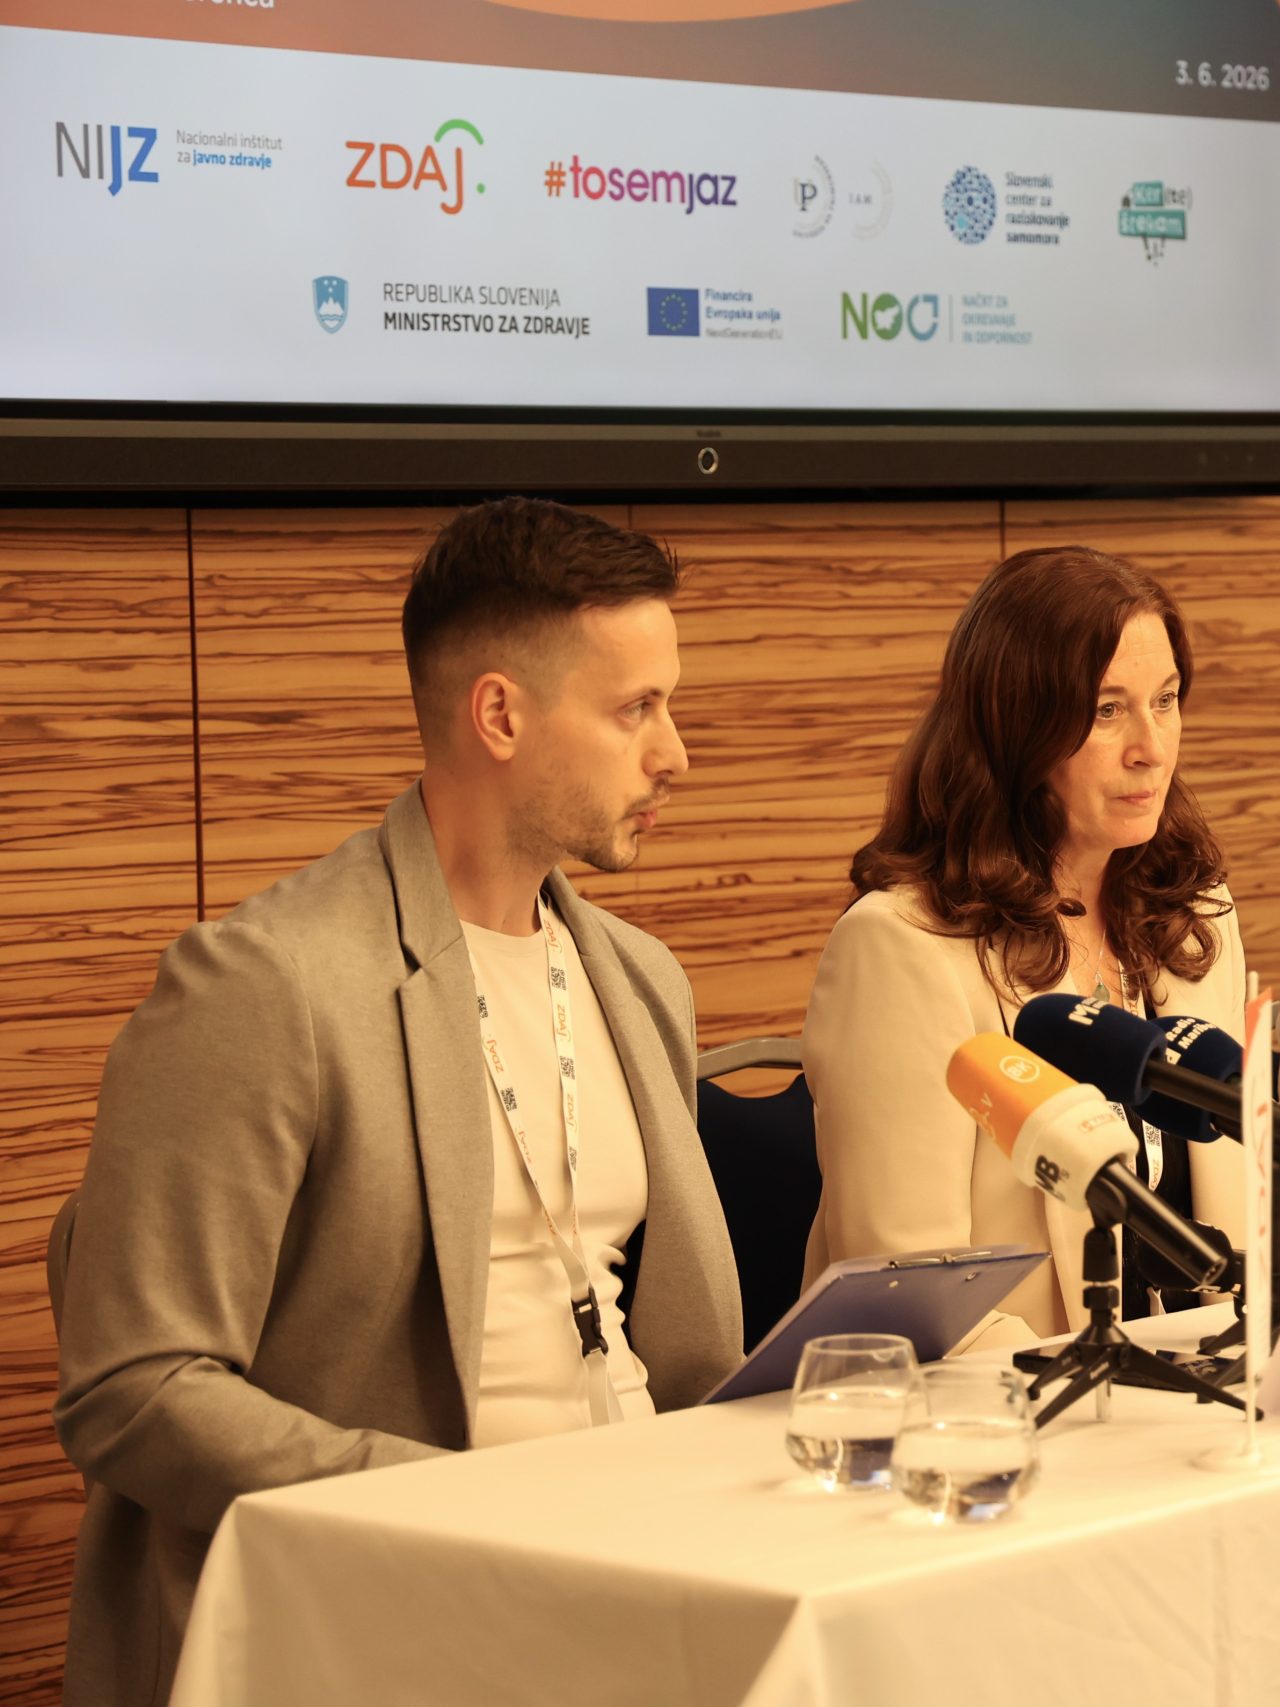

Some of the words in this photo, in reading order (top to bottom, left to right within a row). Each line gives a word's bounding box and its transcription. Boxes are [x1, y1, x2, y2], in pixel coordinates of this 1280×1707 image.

[1175, 59, 1194, 86] 3.
[1198, 62, 1217, 88] 6.
[1220, 63, 1270, 91] 2026
[176, 129, 238, 147] Nacionalni
[240, 133, 282, 151] inštitut
[55, 121, 159, 196] NIJZ
[177, 151, 191, 163] za
[192, 148, 226, 167] javno
[229, 152, 272, 171] zdravje
[544, 154, 738, 215] #tosemjaz
[383, 282, 475, 305] REPUBLIKA
[479, 286, 561, 310] SLOVENIJA
[383, 311, 494, 335] MINISTRSTVO
[499, 316, 521, 334] ZA
[523, 317, 591, 340] ZDRAVJE
[705, 305, 753, 322] Evropska
[755, 307, 782, 323] unija
